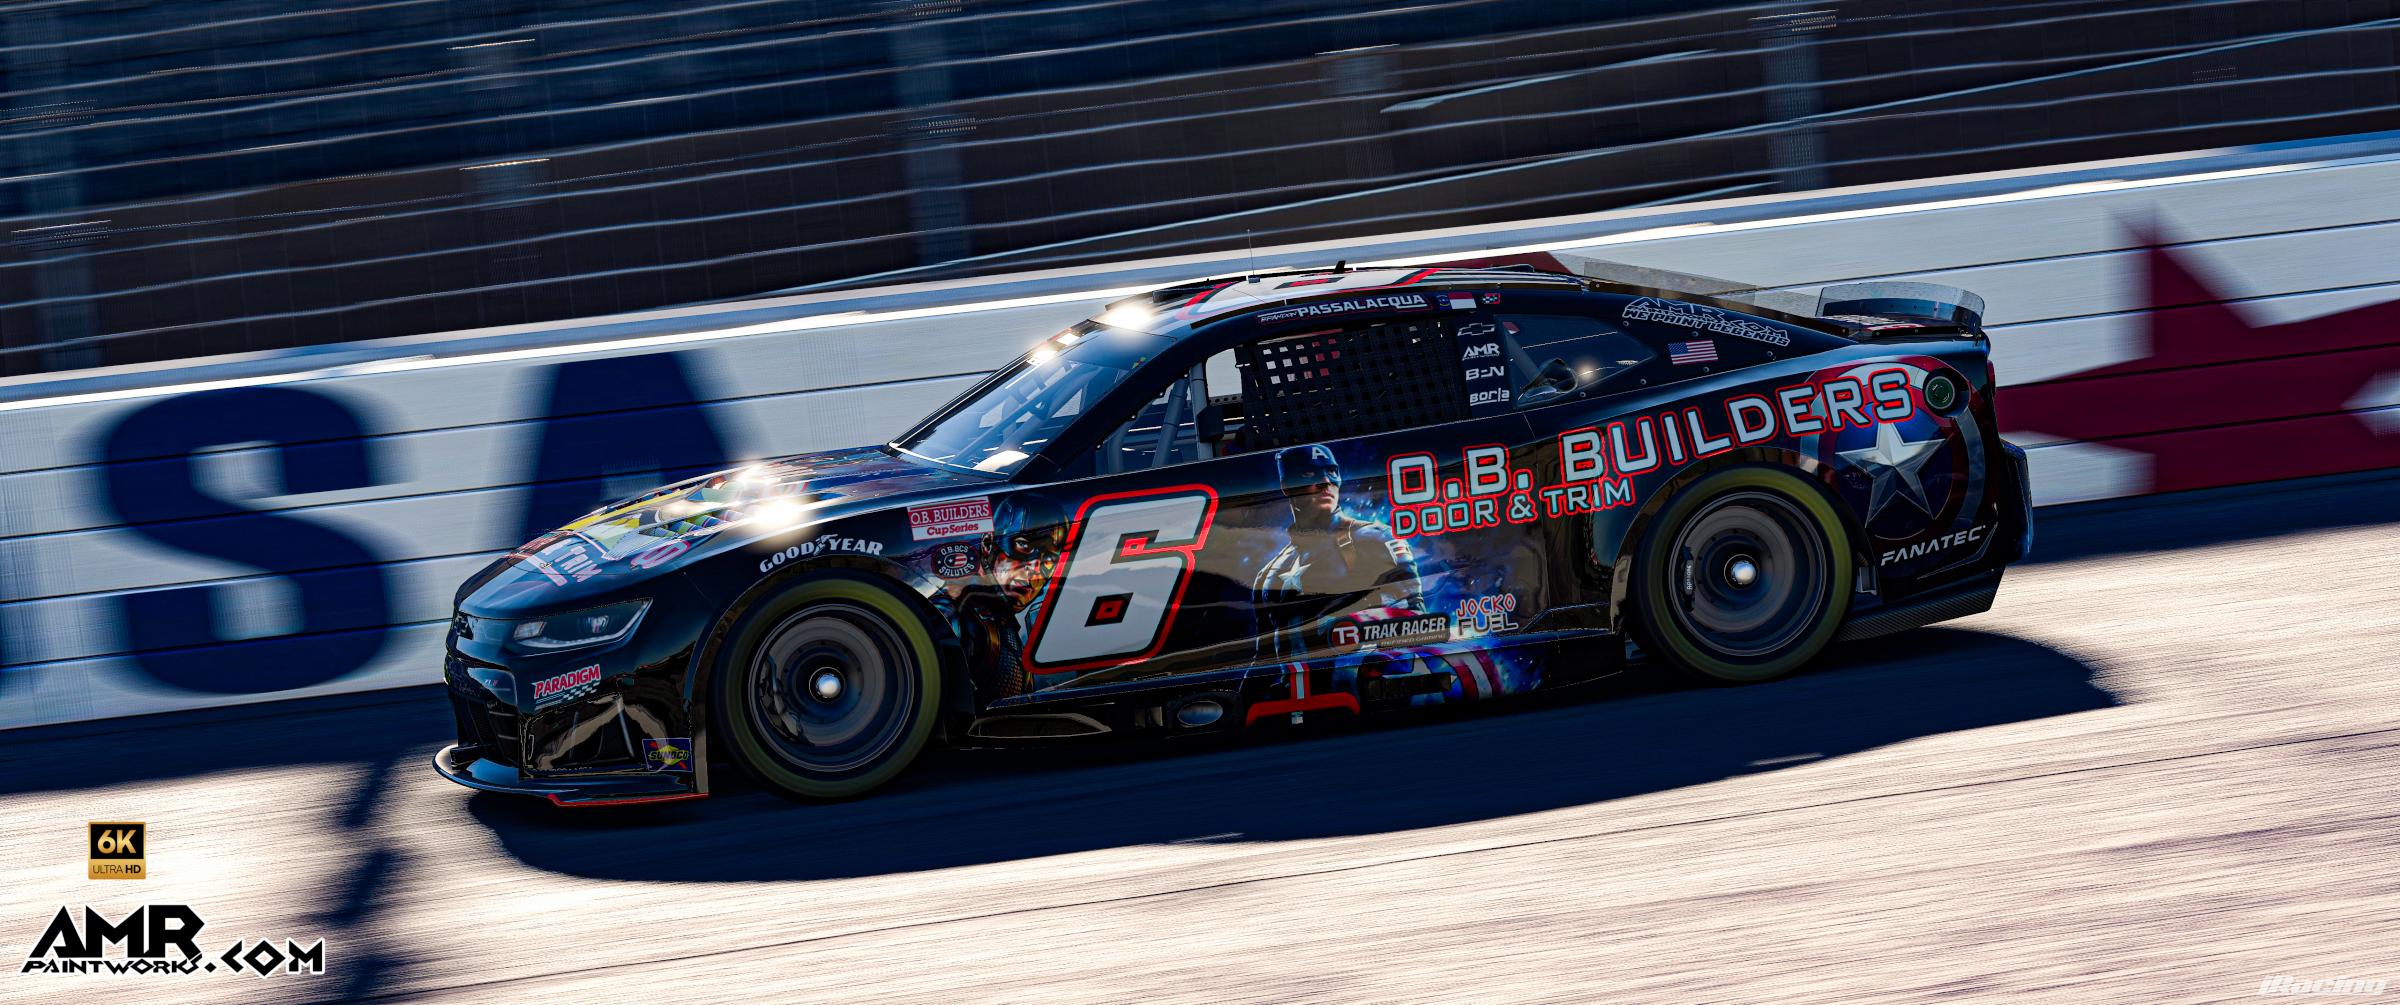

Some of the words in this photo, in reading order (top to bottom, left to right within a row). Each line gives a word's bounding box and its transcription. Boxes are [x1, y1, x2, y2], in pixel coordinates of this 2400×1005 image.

[1297, 294, 1428, 317] PASSALACQUA
[1462, 342, 1501, 361] AMR
[1389, 444, 1532, 507] O.B.
[1561, 368, 1915, 484] BUILDERS
[933, 504, 989, 521] BUILDERS
[1392, 499, 1500, 538] DOOR
[1509, 490, 1536, 520] &
[1543, 476, 1634, 516] TRIM
[927, 526, 948, 536] Cup
[949, 523, 979, 533] Series
[759, 534, 884, 573] GOODYEAR
[1880, 525, 1986, 567] FANATEC
[939, 562, 975, 576] SALUTES
[1023, 484, 1217, 674] 6
[1457, 592, 1517, 618] JOCKO
[1363, 623, 1401, 641] TRAK
[1401, 616, 1447, 635] RACER
[1456, 611, 1519, 637] FUEL
[532, 664, 601, 699] PARADIGM
[649, 750, 689, 760] SUNOCO
